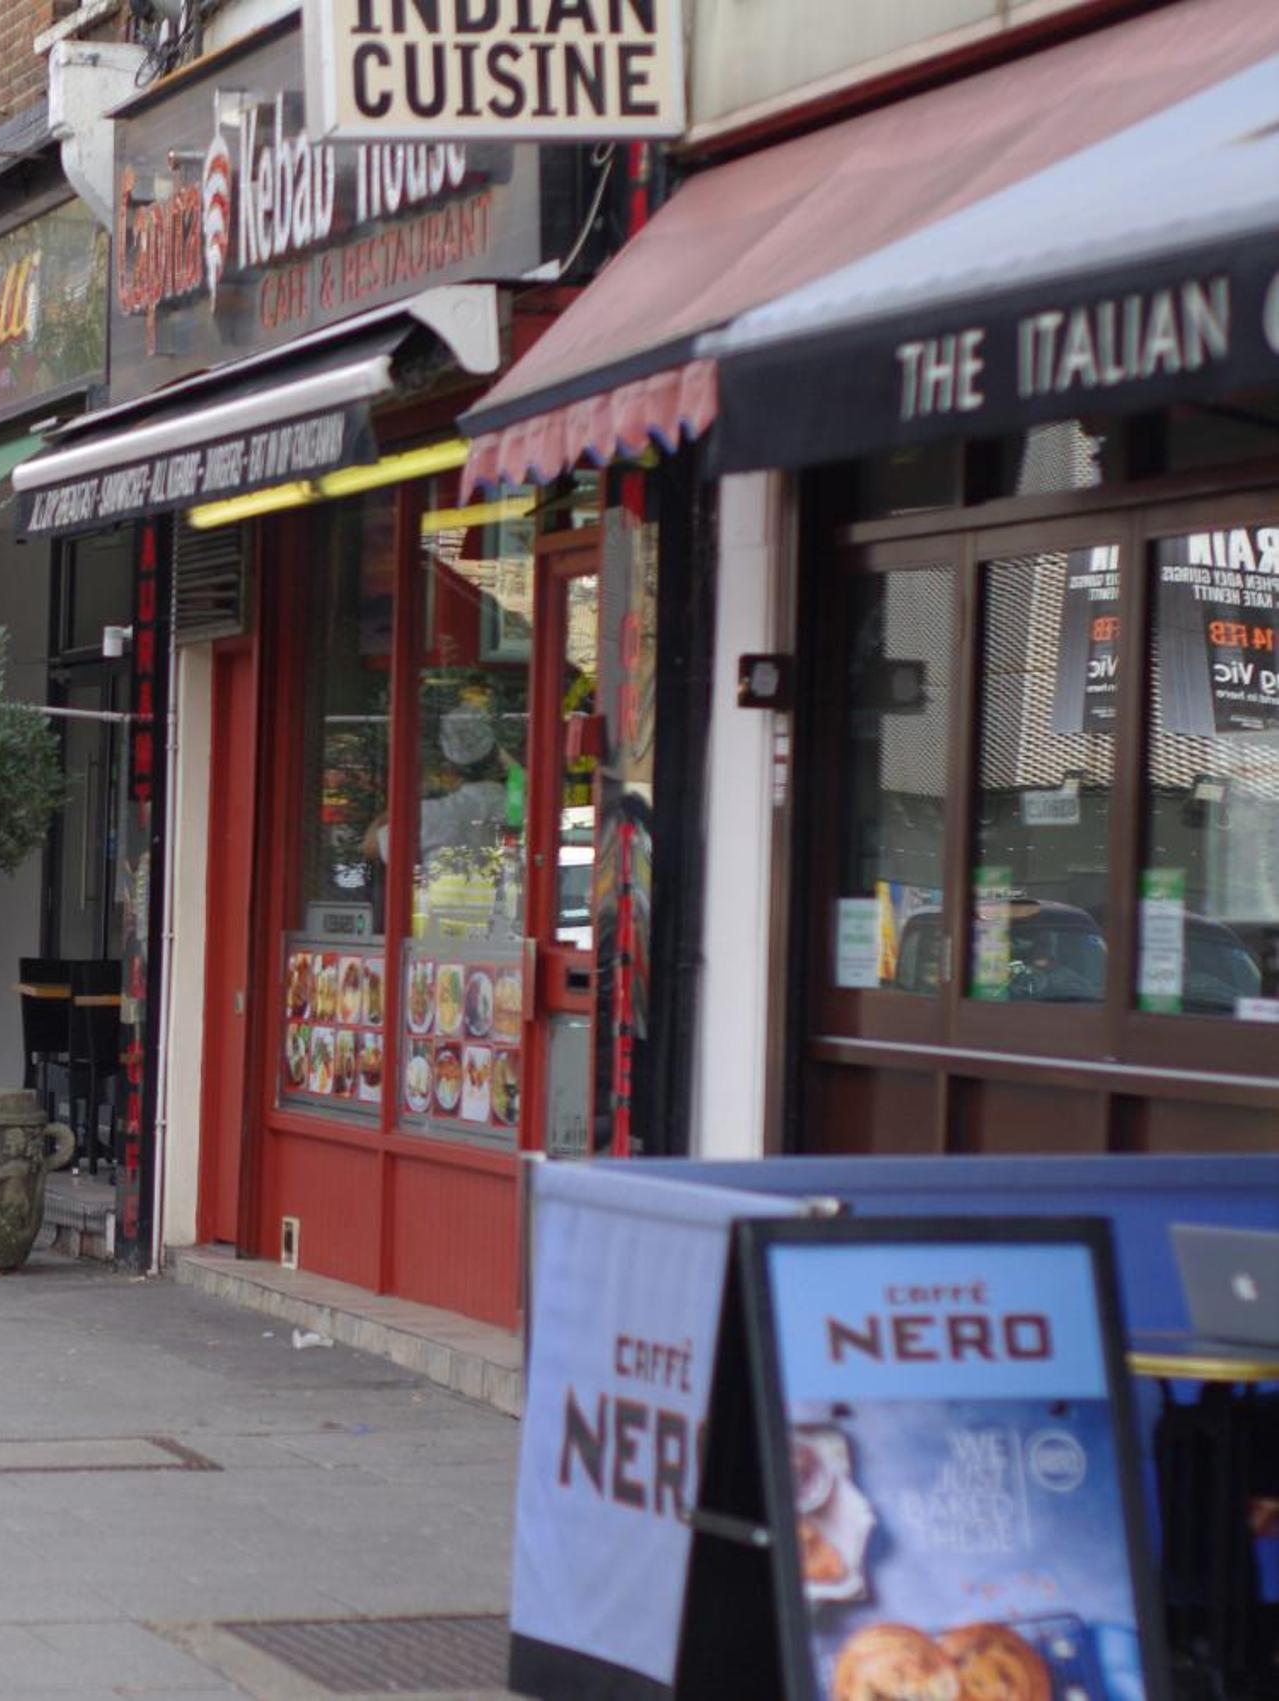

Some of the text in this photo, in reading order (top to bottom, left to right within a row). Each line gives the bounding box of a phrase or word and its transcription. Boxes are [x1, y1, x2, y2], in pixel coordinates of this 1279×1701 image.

[351, 40, 660, 119] CUISINE
[340, 190, 494, 304] RESTAURANT
[896, 327, 986, 422] THE
[1018, 275, 1230, 399] ITALIAN
[824, 1312, 1055, 1364] NERO
[558, 1383, 707, 1526] NER
